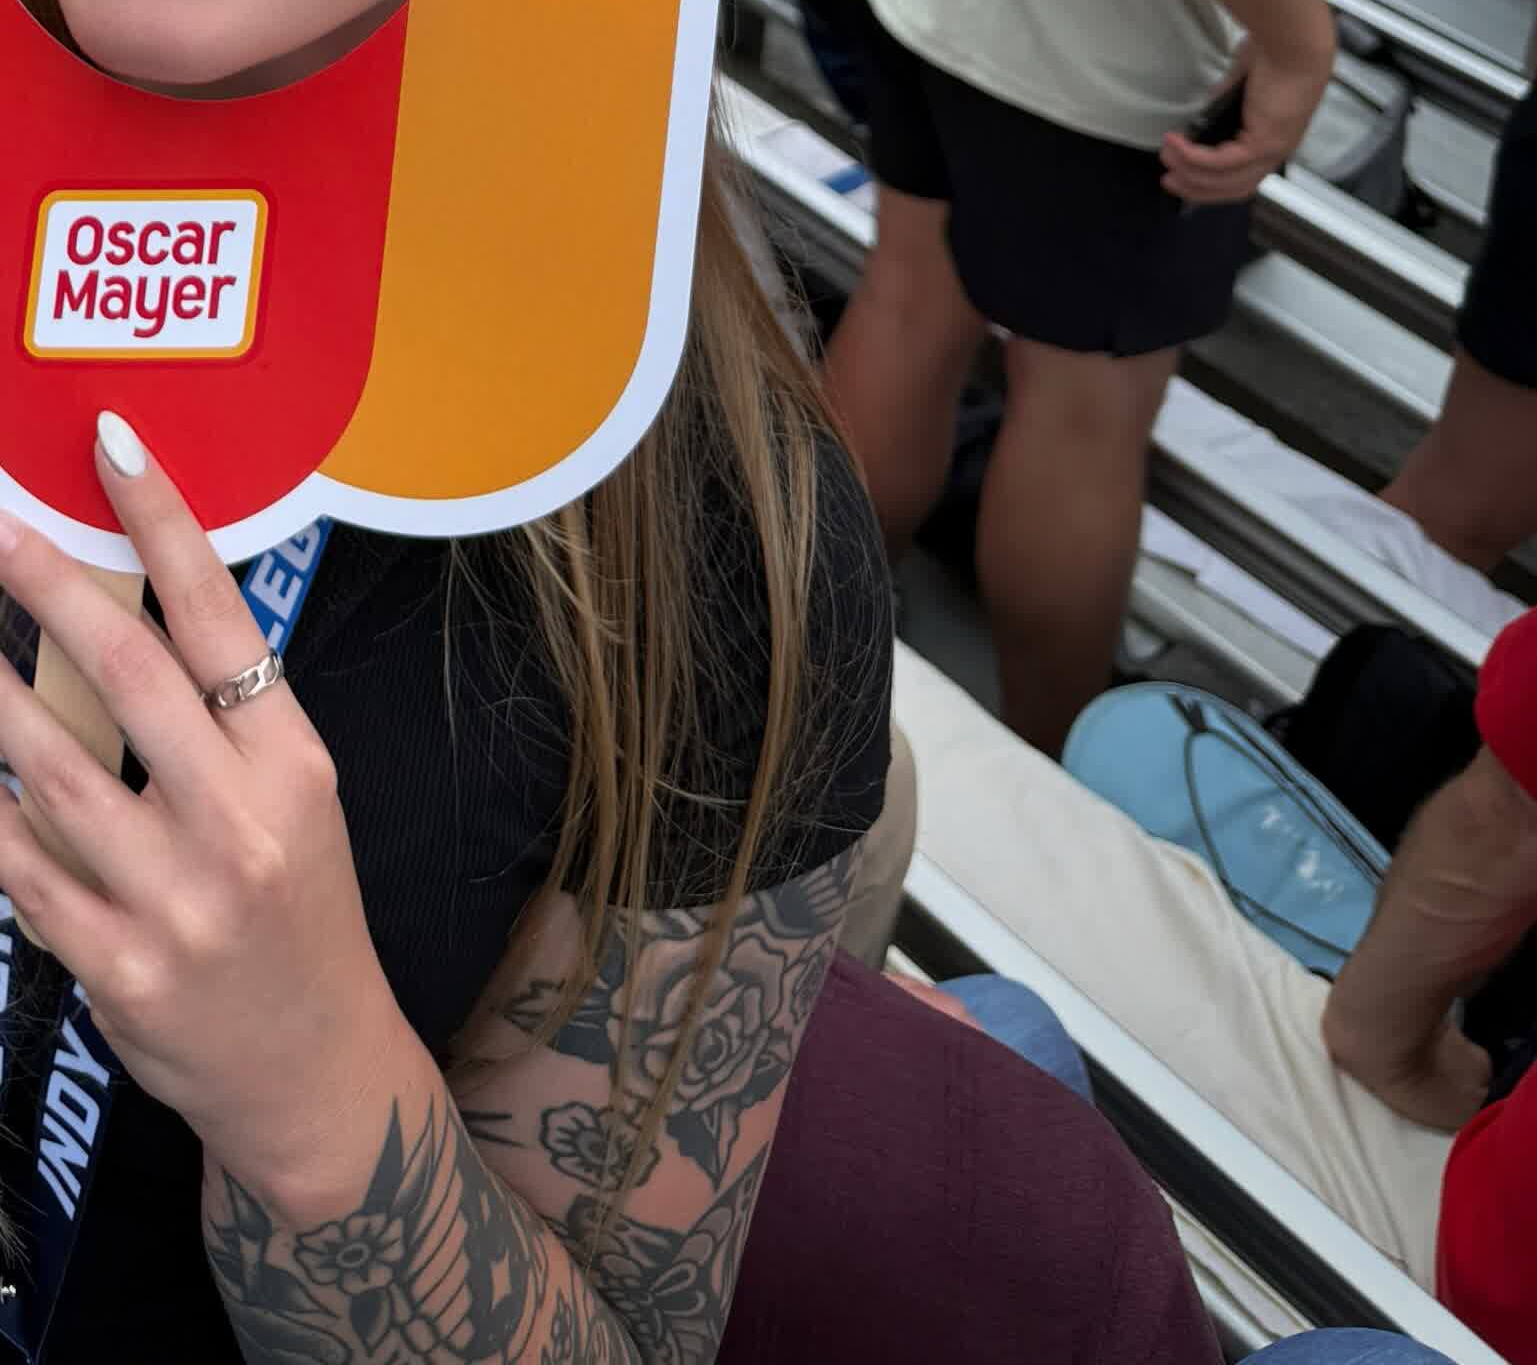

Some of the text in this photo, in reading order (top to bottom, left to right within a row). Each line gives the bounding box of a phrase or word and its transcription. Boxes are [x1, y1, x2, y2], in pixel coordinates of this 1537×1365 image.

[66, 215, 237, 266] Oscar
[52, 269, 238, 339] Mayer
[37, 1017, 110, 1221] INDY
